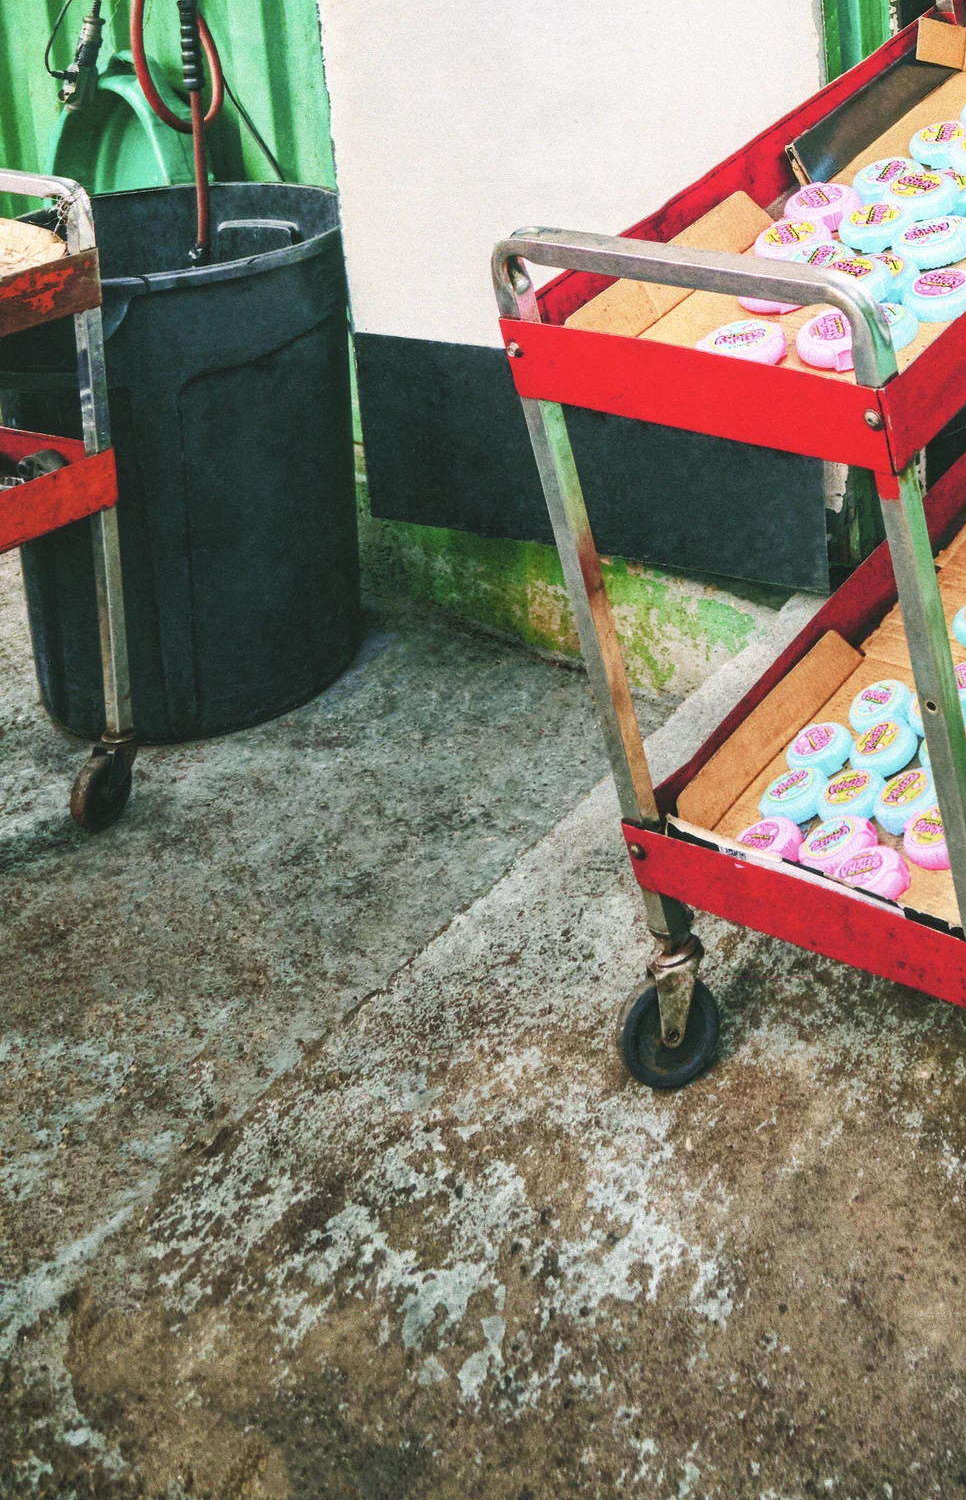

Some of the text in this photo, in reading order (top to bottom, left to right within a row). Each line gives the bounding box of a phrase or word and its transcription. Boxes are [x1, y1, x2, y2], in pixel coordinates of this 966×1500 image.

[898, 175, 940, 190] Sticky
[904, 222, 950, 240] Sticky
[918, 274, 966, 287] Sticky
[716, 328, 766, 347] Sticky
